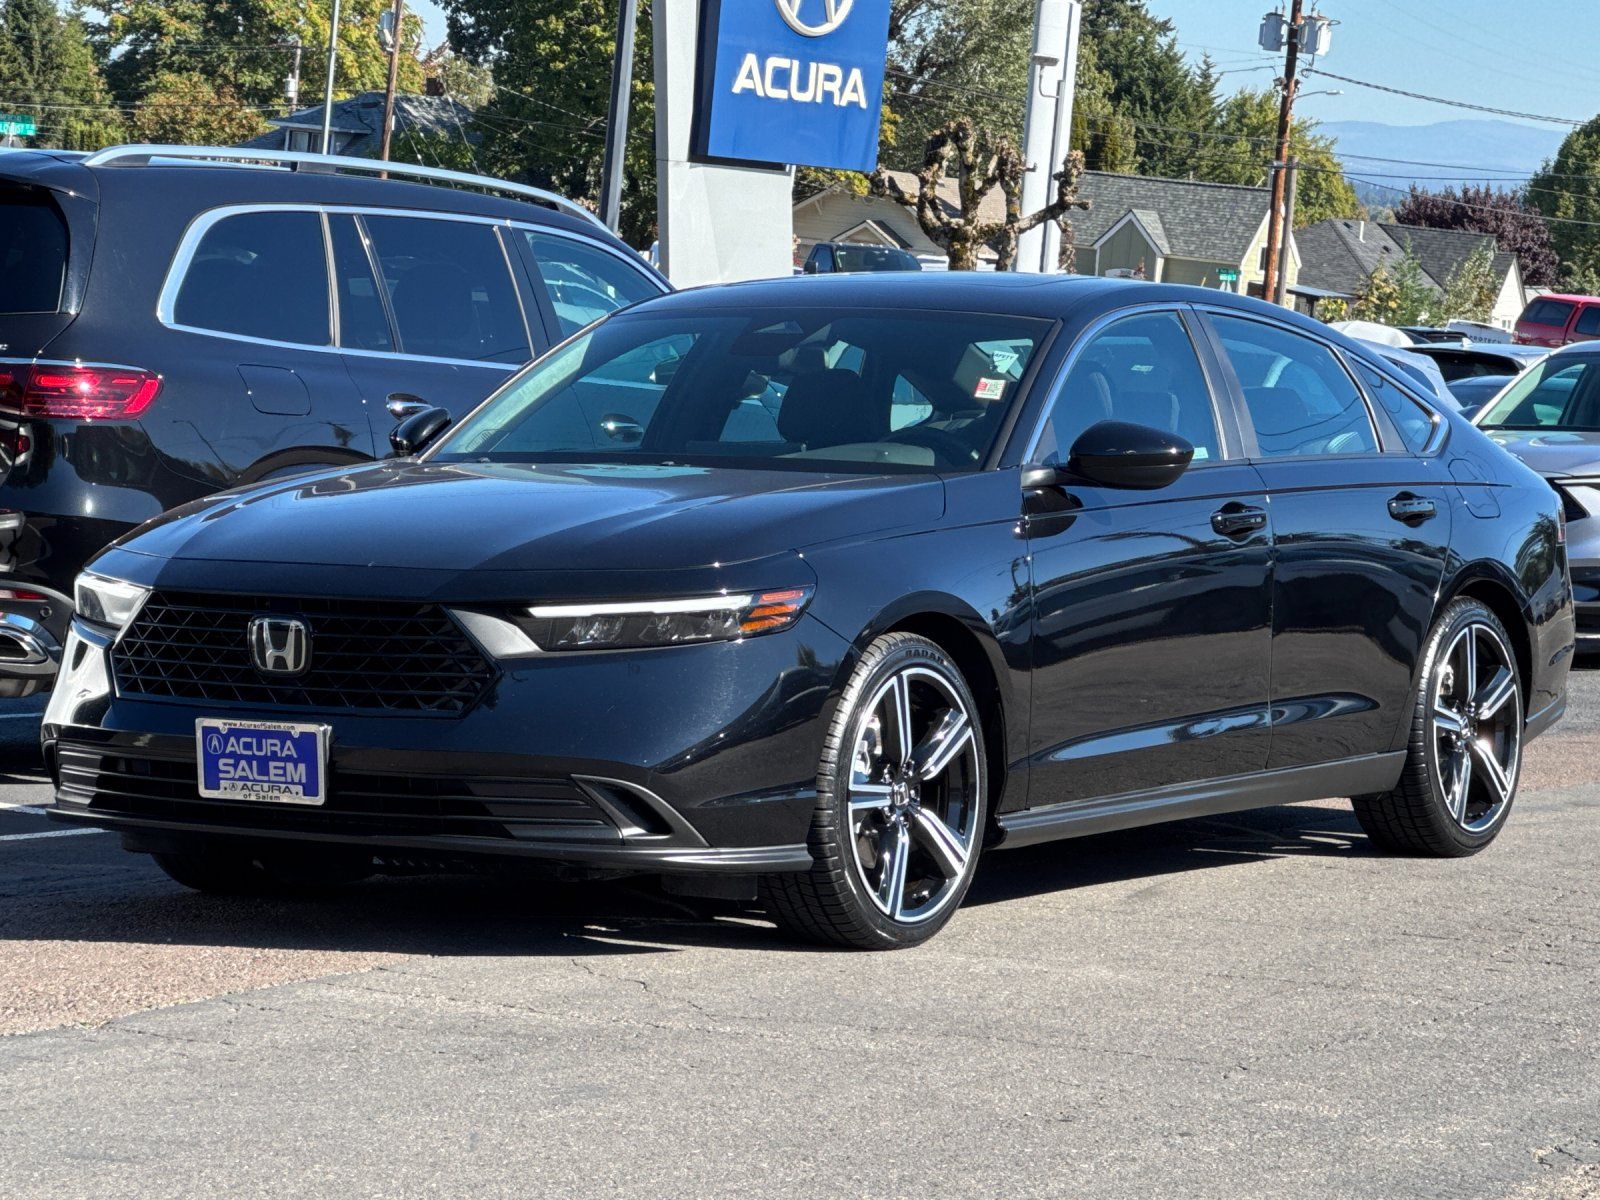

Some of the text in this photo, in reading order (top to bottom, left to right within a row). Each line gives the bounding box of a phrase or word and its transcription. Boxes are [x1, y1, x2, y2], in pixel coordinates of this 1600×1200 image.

[731, 53, 867, 109] ACURA
[905, 649, 945, 665] RADAR
[221, 721, 296, 731] www.AcuraofSalem.com
[225, 736, 298, 759] ACURA
[218, 758, 307, 784] SALEM
[240, 783, 293, 795] ACURA
[255, 793, 281, 801] Salem
